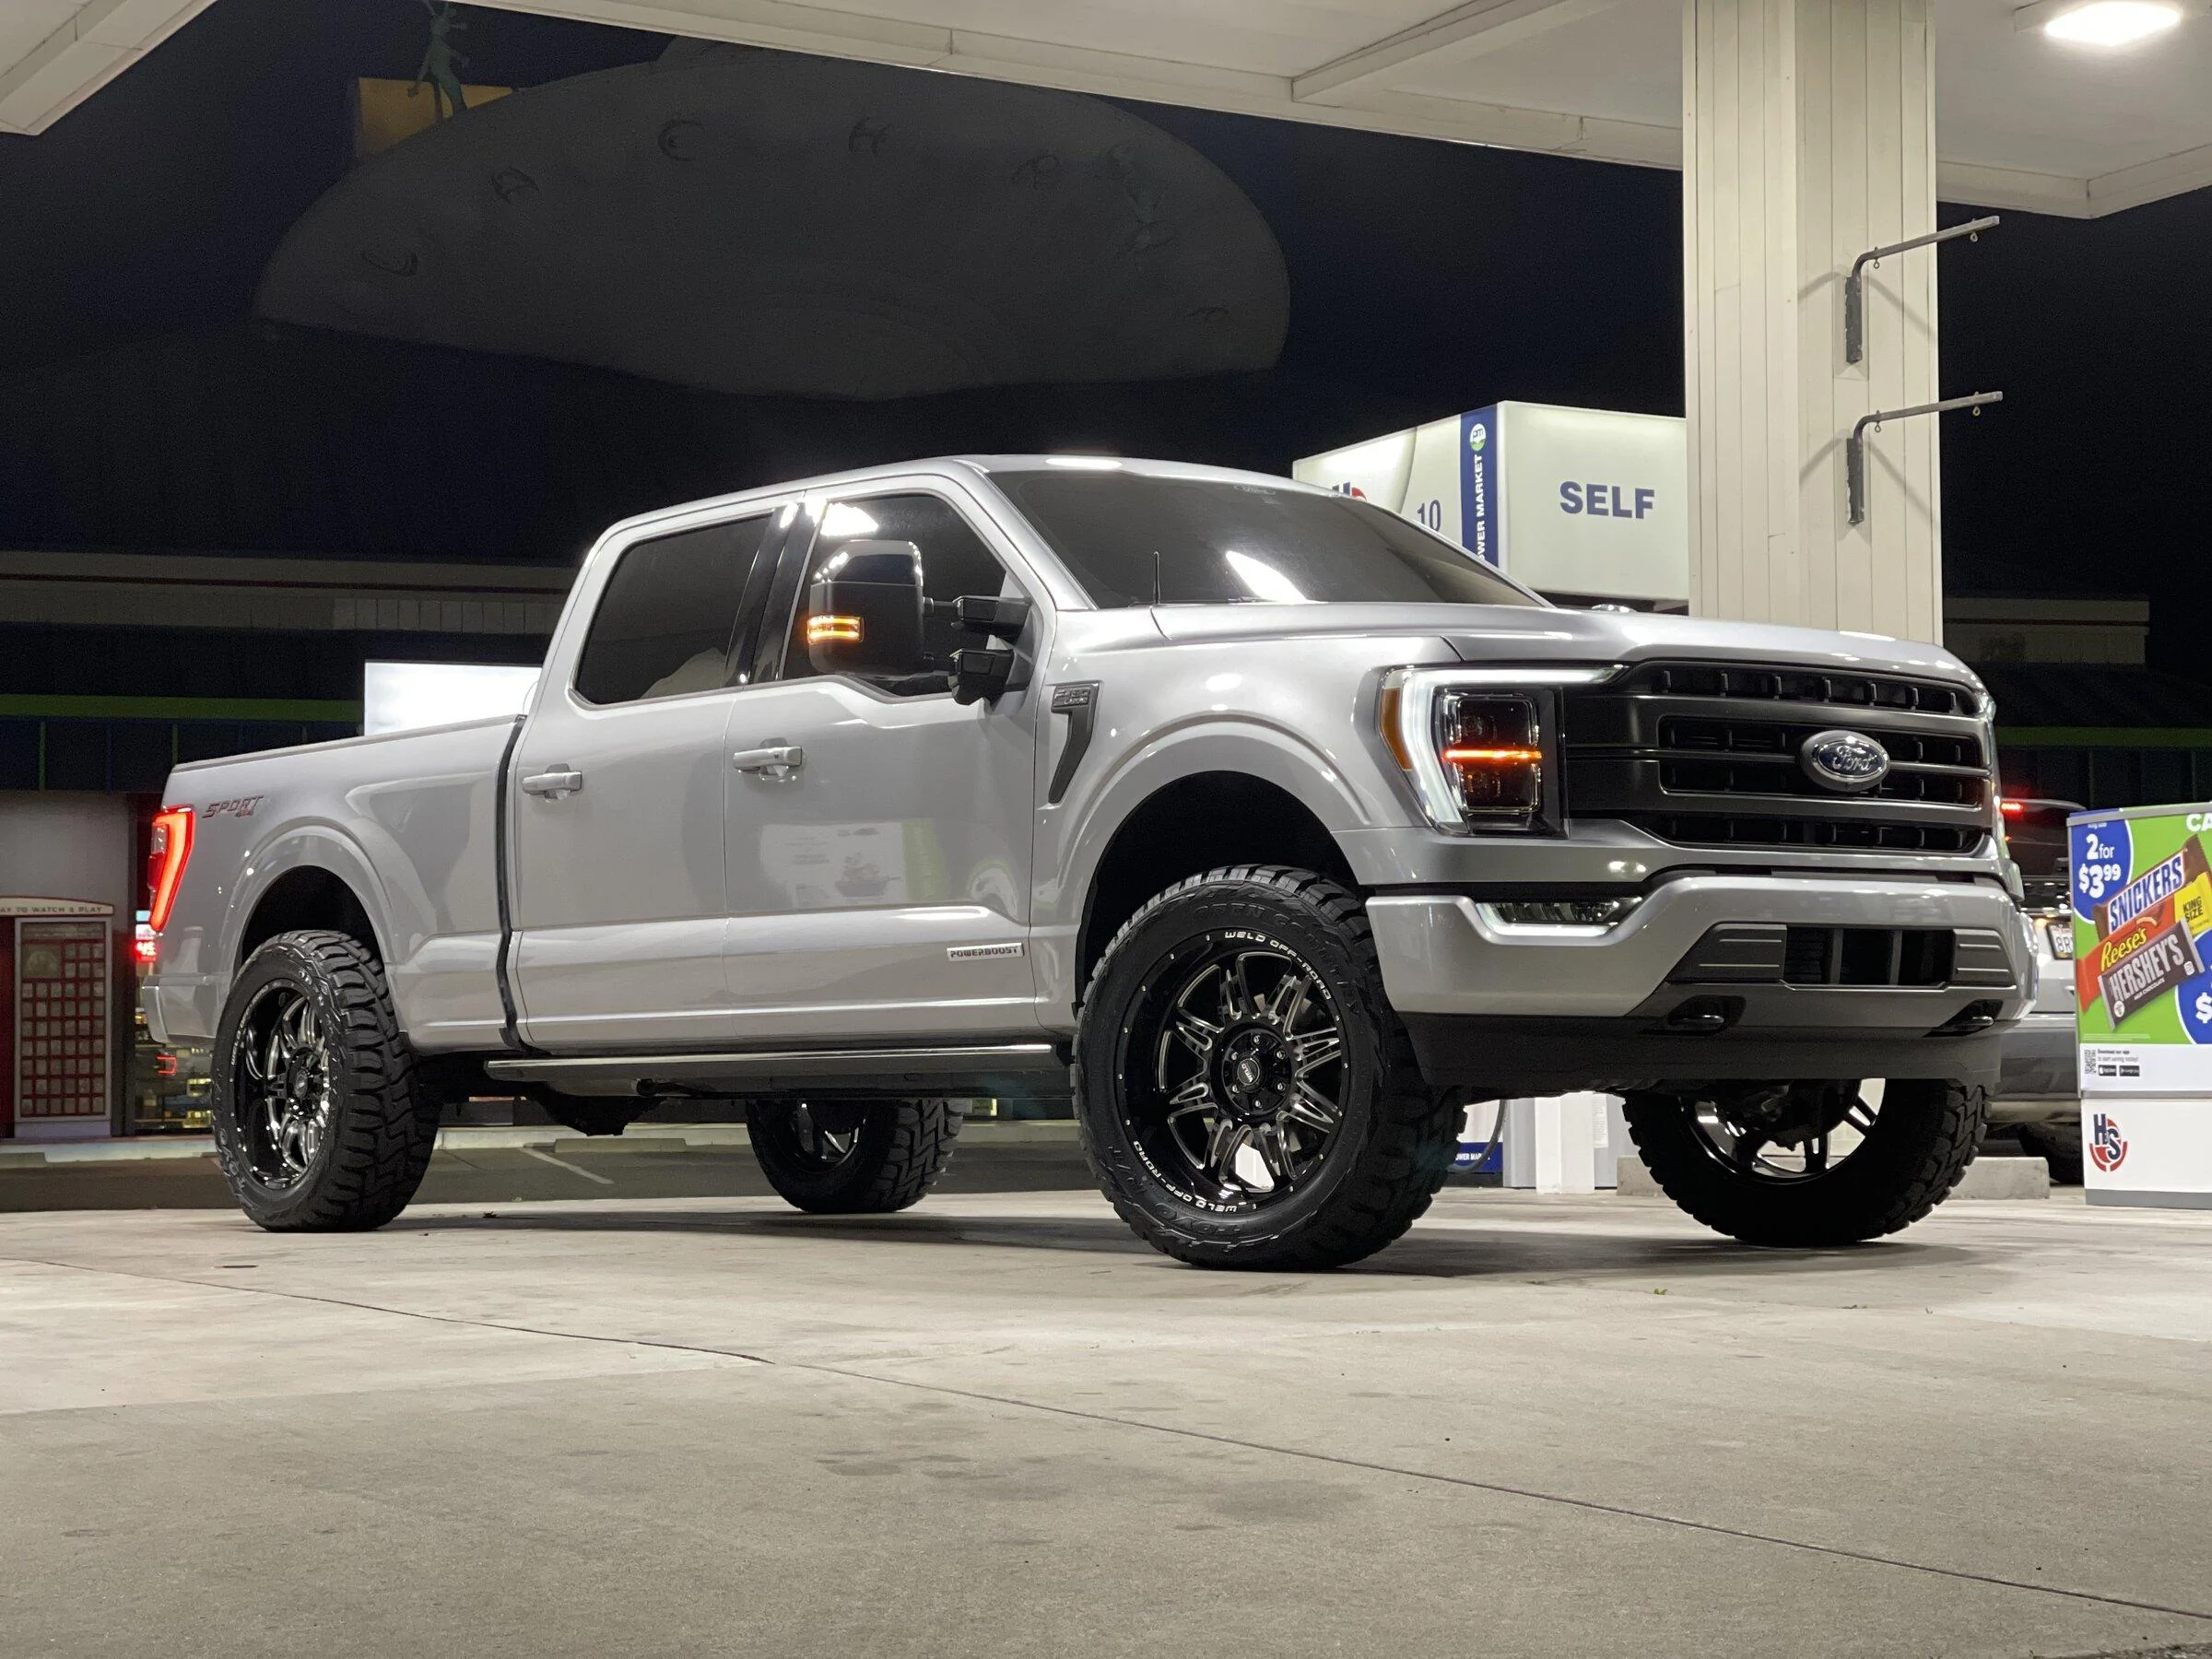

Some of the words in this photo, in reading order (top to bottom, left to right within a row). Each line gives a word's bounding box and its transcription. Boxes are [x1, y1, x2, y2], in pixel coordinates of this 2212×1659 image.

[1474, 454, 1485, 517] MARKET
[1559, 480, 1655, 520] SELF
[1417, 499, 1441, 532] 10
[1831, 745, 1878, 771] Ford
[202, 794, 265, 819] SPORT
[2185, 813, 2212, 832] CA
[2086, 833, 2099, 860] 2
[2099, 843, 2115, 859] for
[2109, 855, 2183, 934] SNICKERS
[2183, 896, 2203, 913] KING
[2185, 905, 2204, 923] SIZE
[950, 946, 1018, 958] POWERBOOST
[2055, 936, 2074, 954] 8R
[2101, 927, 2147, 971] Reese's
[1224, 931, 1266, 943] WELD
[1269, 940, 1332, 1000] OFF-ROAD
[2110, 934, 2184, 1002] HERSHEY'S
[1133, 1140, 1193, 1202] OFF-ROAD
[1194, 1198, 1238, 1213] WELD
